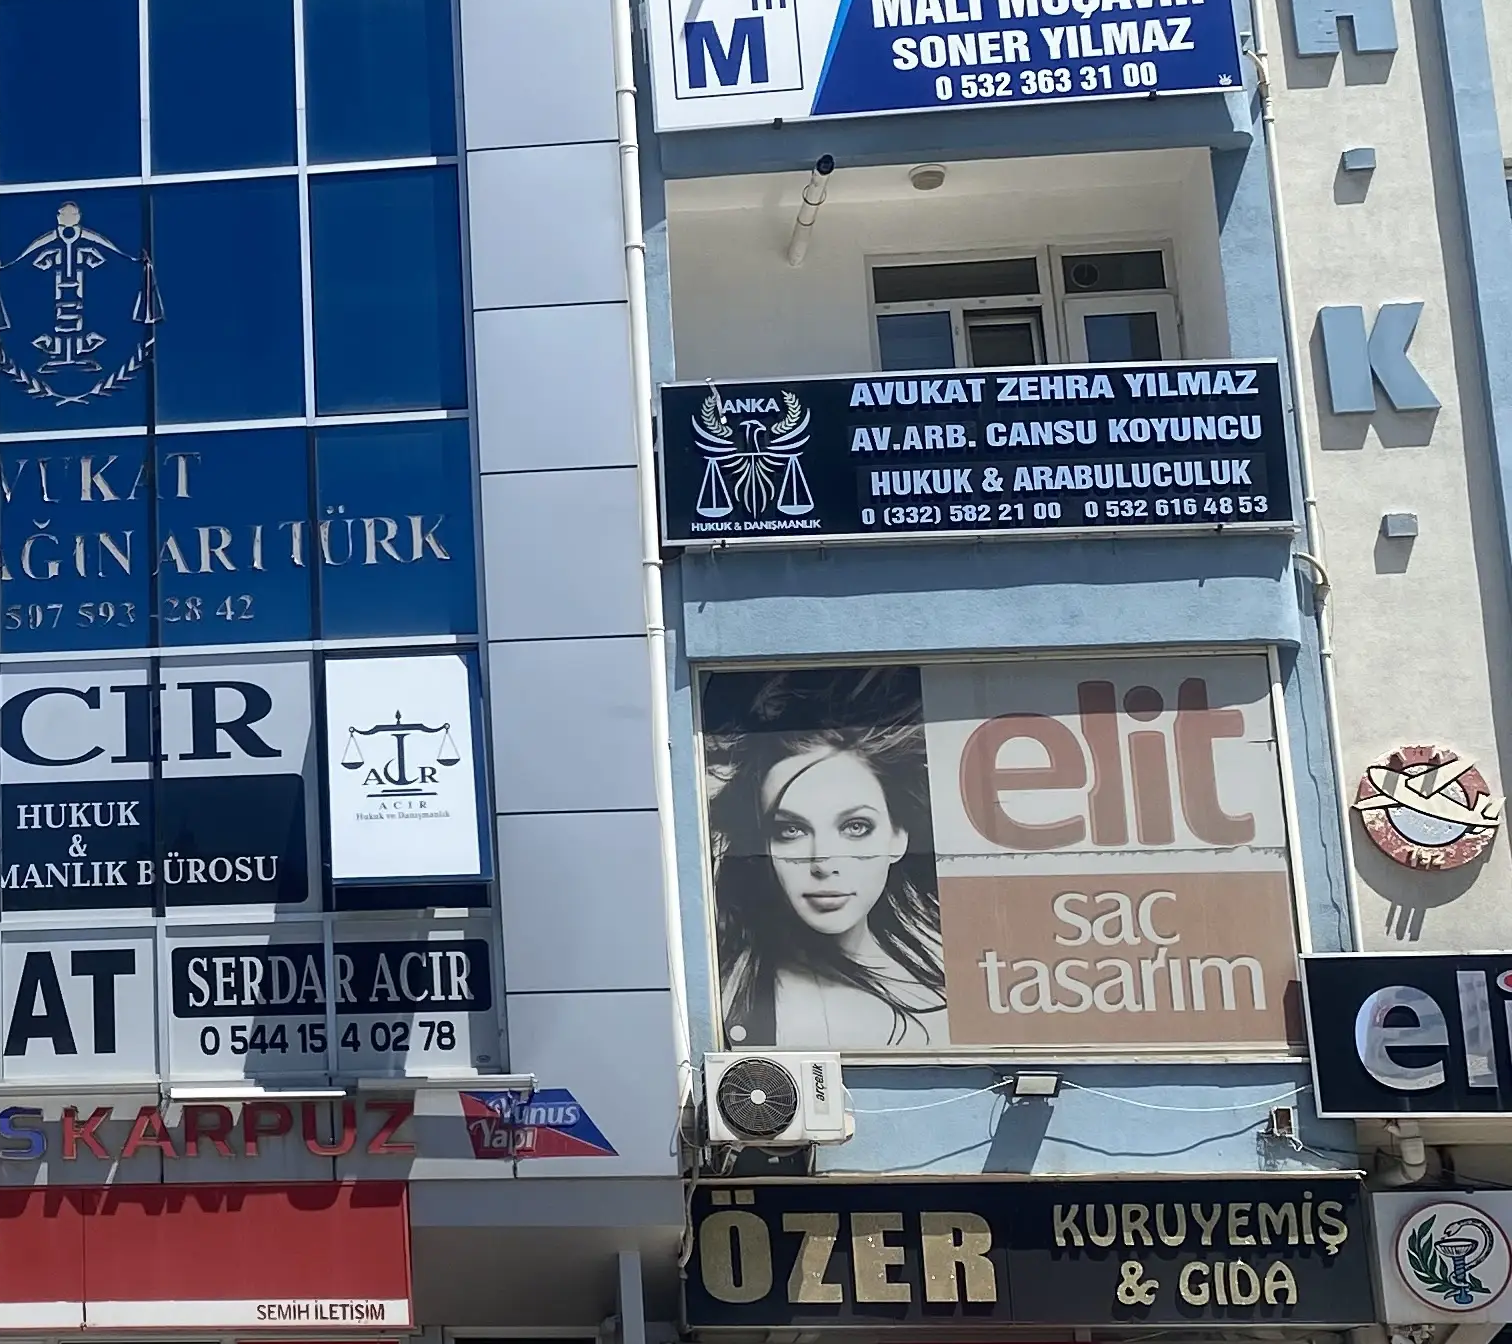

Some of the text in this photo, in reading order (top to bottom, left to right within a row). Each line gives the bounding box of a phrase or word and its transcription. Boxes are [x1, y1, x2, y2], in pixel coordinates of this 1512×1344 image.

[891, 16, 1196, 72] SONER YILMAZ
[934, 60, 1158, 102] 0 532 363 31 00
[720, 395, 782, 417] ANKA
[849, 368, 1261, 409] AVUKAT ZEHRA YILMAZ
[986, 418, 1098, 449] CANSU
[1108, 413, 1264, 445] KOYUNCU
[870, 458, 1252, 497] HUKUK & ARABULUCULUK
[860, 500, 1062, 528] 0 (332) 582 21 00
[1083, 493, 1270, 519] 0 532 616 48 53
[690, 520, 732, 532] HUKUK
[215, 593, 255, 622] 42
[959, 677, 1256, 852] elit
[16, 800, 140, 832] HUKUK
[67, 833, 88, 859] &
[136, 851, 279, 888] BÜROSU
[1053, 890, 1180, 958] saç
[187, 952, 358, 1010] SERDAR
[372, 949, 475, 1003] ACIR
[199, 1025, 220, 1057] 0
[231, 1023, 289, 1056] 544
[370, 1021, 411, 1053] 02
[419, 1020, 457, 1051] 78
[811, 1063, 828, 1102] arçelik
[61, 1100, 416, 1160] KARPUZ
[698, 1188, 1349, 1306] ÖZER KURUYEMİŞ
[1116, 1260, 1299, 1306] & GIDA
[256, 1299, 386, 1325] SEMİH İLETİŞİM
